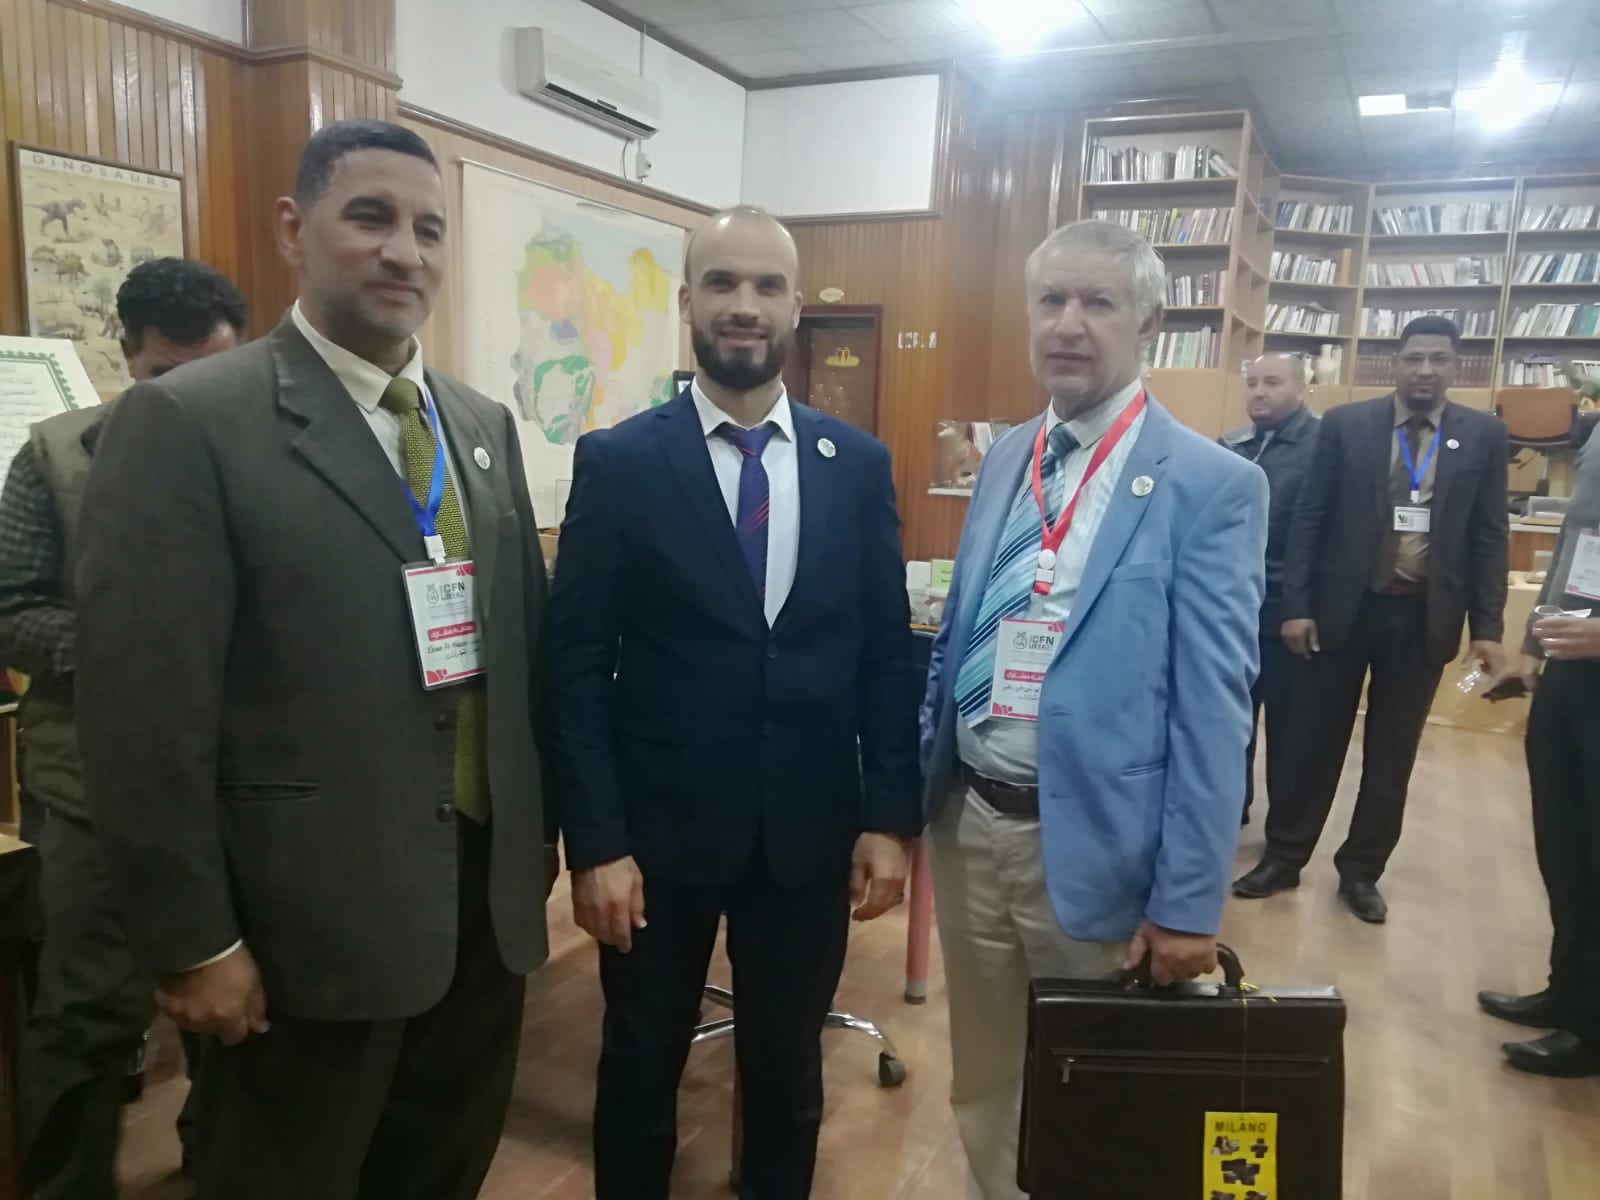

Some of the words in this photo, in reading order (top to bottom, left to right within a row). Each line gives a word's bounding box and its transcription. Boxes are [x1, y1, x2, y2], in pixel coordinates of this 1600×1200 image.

[32, 154, 169, 188] DINOSAURS
[440, 581, 465, 593] ICFN
[1030, 634, 1055, 646] ICFN
[1215, 1121, 1266, 1133] MILANO
